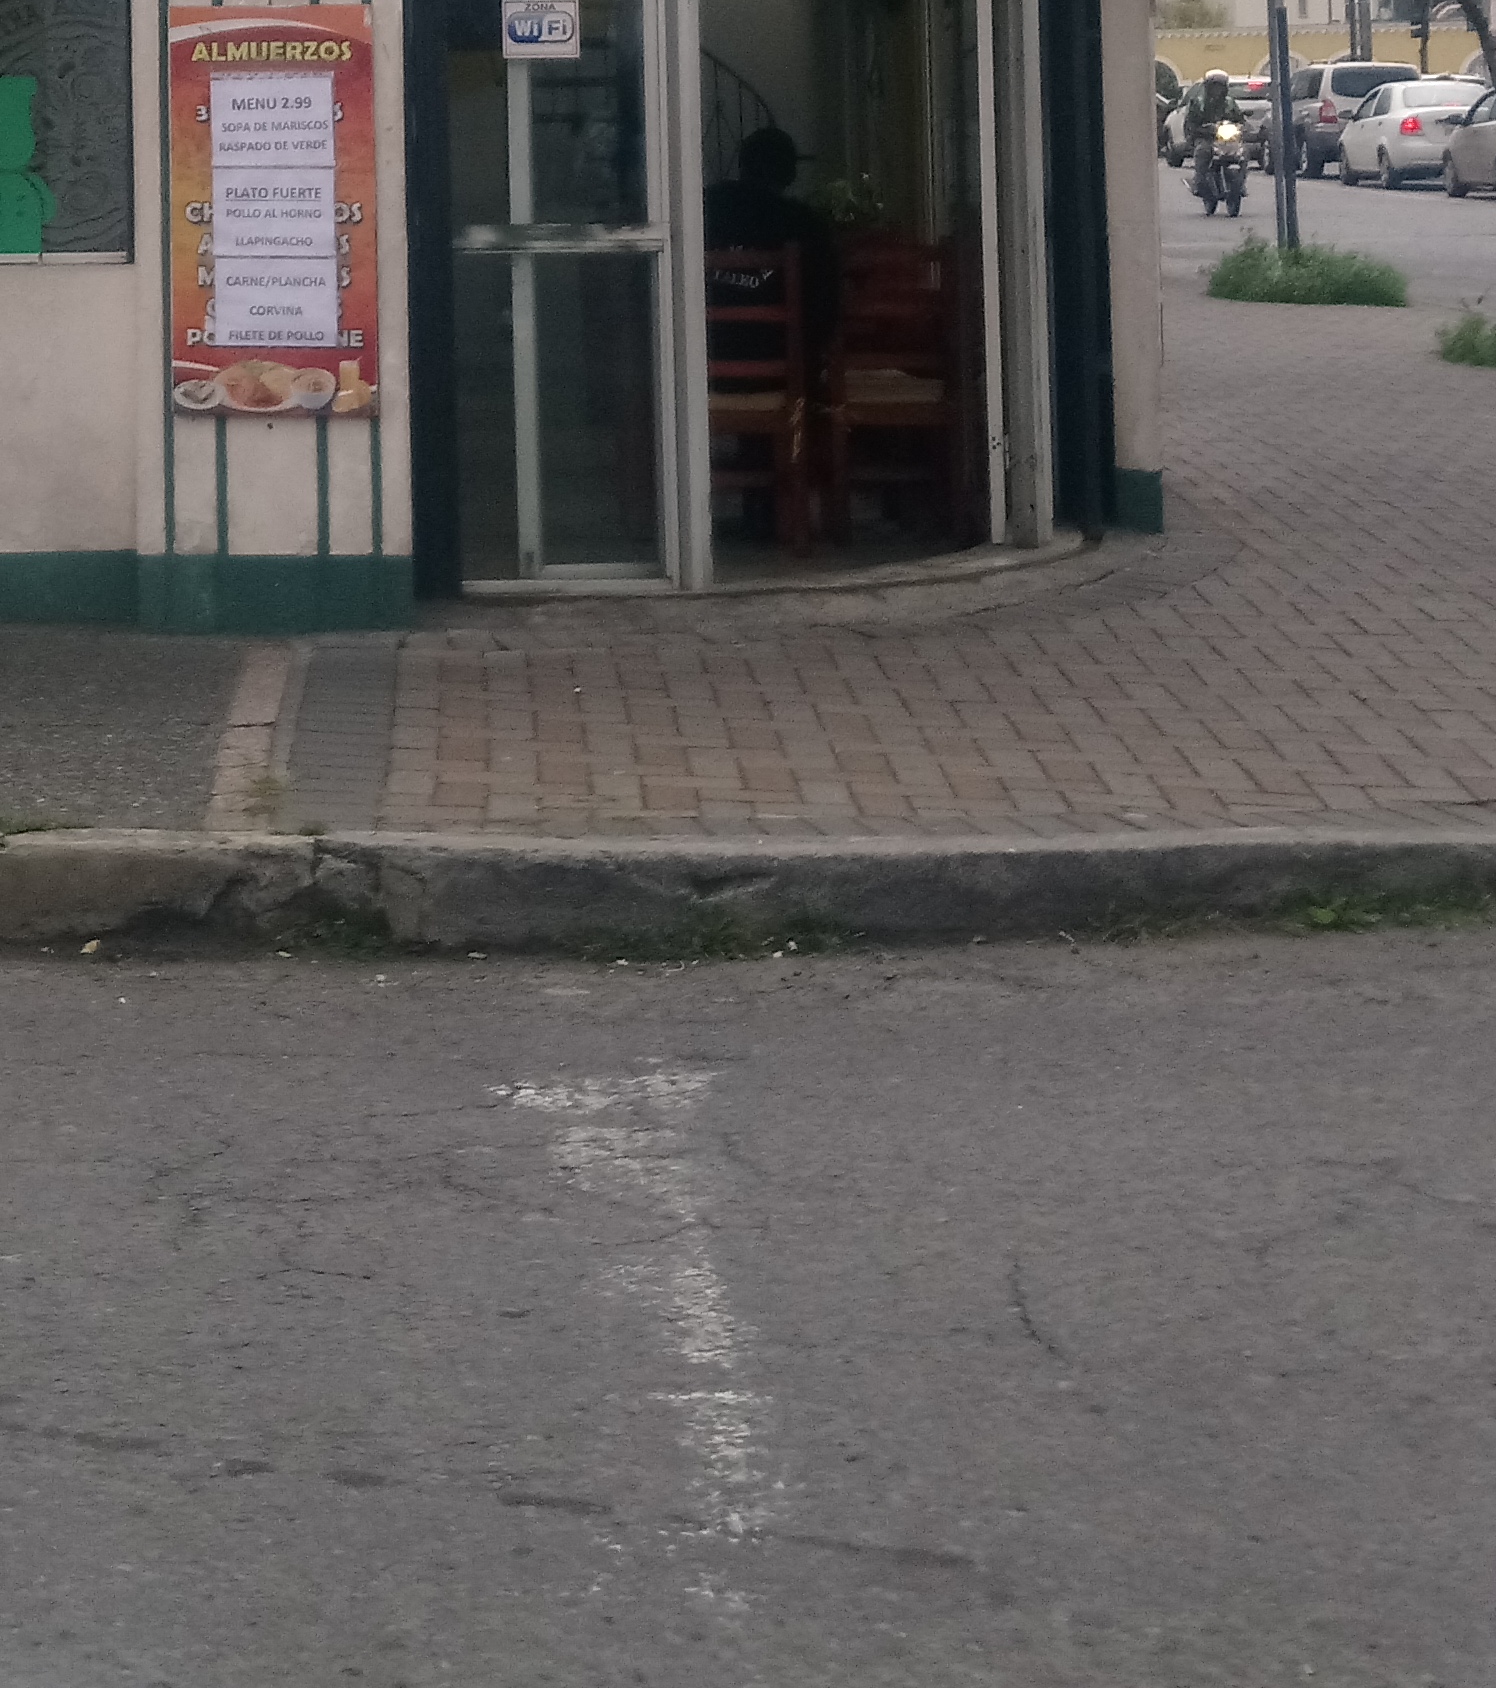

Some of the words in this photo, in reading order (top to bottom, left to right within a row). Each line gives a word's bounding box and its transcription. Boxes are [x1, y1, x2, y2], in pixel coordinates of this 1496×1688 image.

[524, 3, 557, 12] ZONA
[191, 40, 353, 63] ALMUERZOS
[231, 97, 277, 111] MENU
[281, 96, 313, 110] 2.99
[221, 121, 251, 133] SOPA
[253, 121, 268, 132] DE
[271, 119, 329, 132] MARISCOS
[218, 141, 271, 152] RASPADO
[274, 140, 289, 151] DE
[291, 139, 328, 151] VERDE
[225, 187, 269, 200] PLATO
[272, 187, 322, 200] FUERTE
[225, 208, 262, 219] POLLO
[263, 208, 278, 219] AL
[280, 208, 323, 219] HORNO
[234, 236, 314, 247] LLAPINGACHO
[225, 275, 327, 289] CARNE/PLANCHA
[248, 305, 304, 316] CORVINA
[228, 330, 265, 341] FILETE
[267, 330, 284, 341] DE
[286, 330, 325, 341] POLLO
